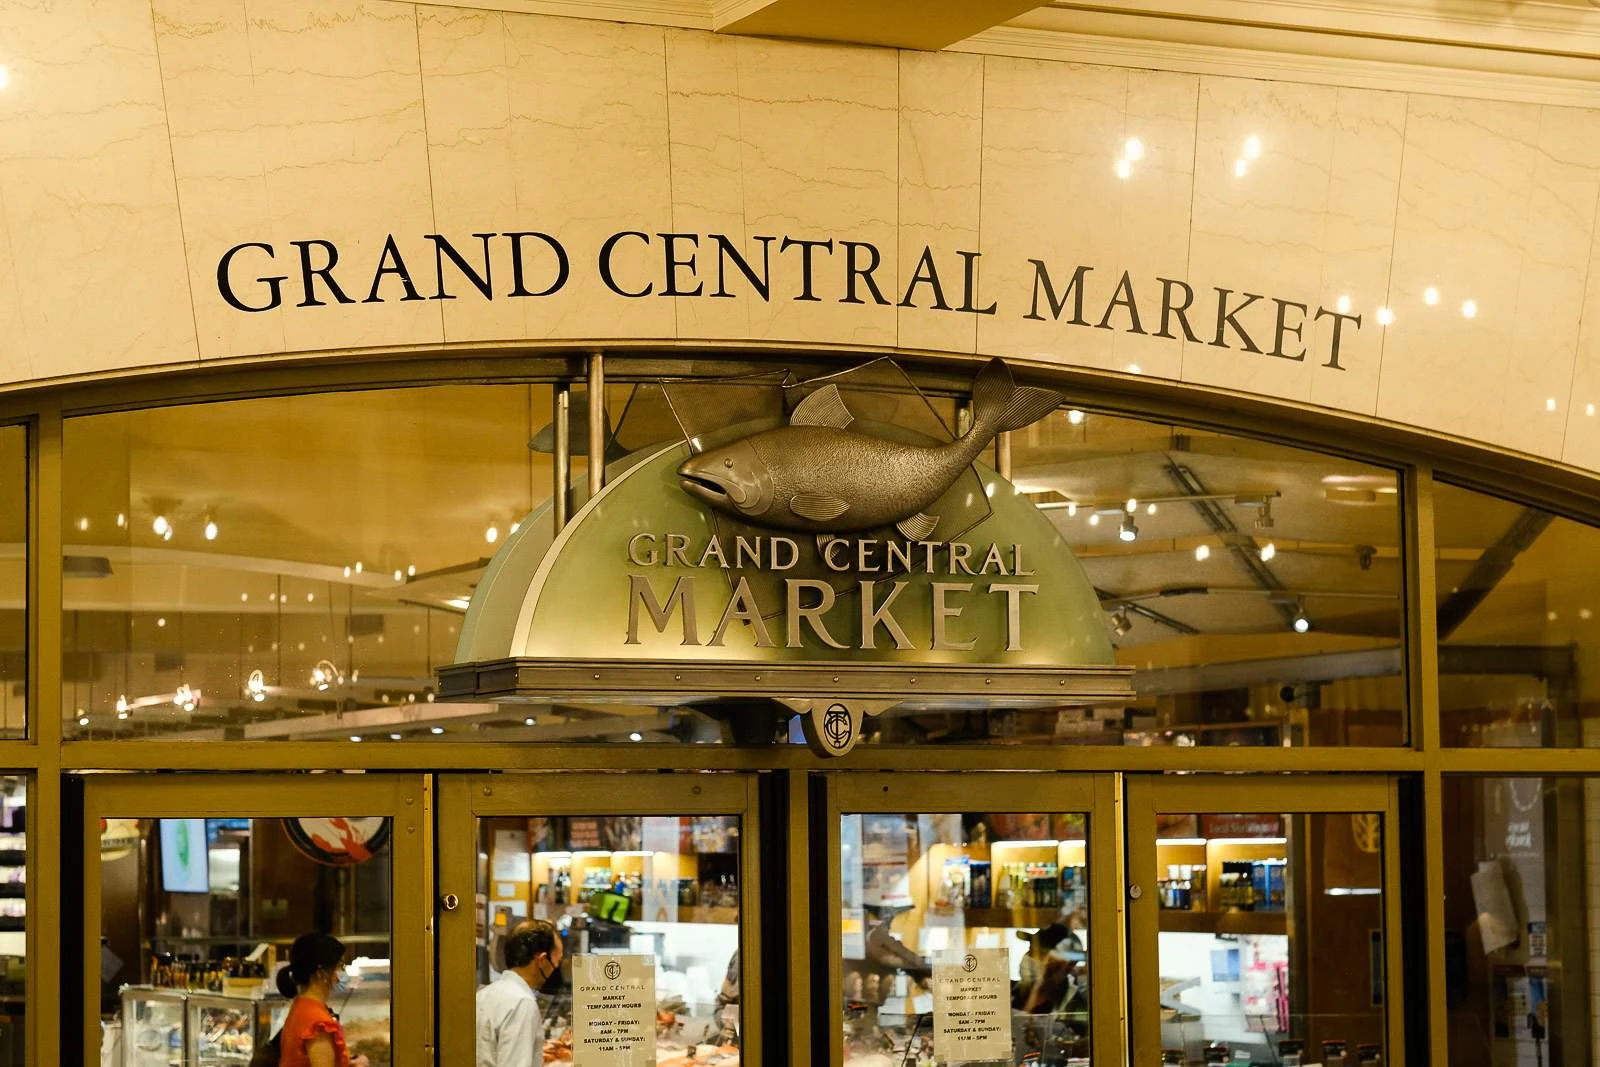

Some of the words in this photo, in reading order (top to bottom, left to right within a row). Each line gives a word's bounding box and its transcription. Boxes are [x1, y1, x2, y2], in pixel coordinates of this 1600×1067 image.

[217, 231, 569, 312] GRAND
[599, 231, 997, 314] CENTRAL
[1023, 258, 1361, 370] MARKET
[628, 533, 799, 571] GRAND
[825, 536, 1039, 577] CENTRAL
[624, 574, 1039, 652] MARKET
